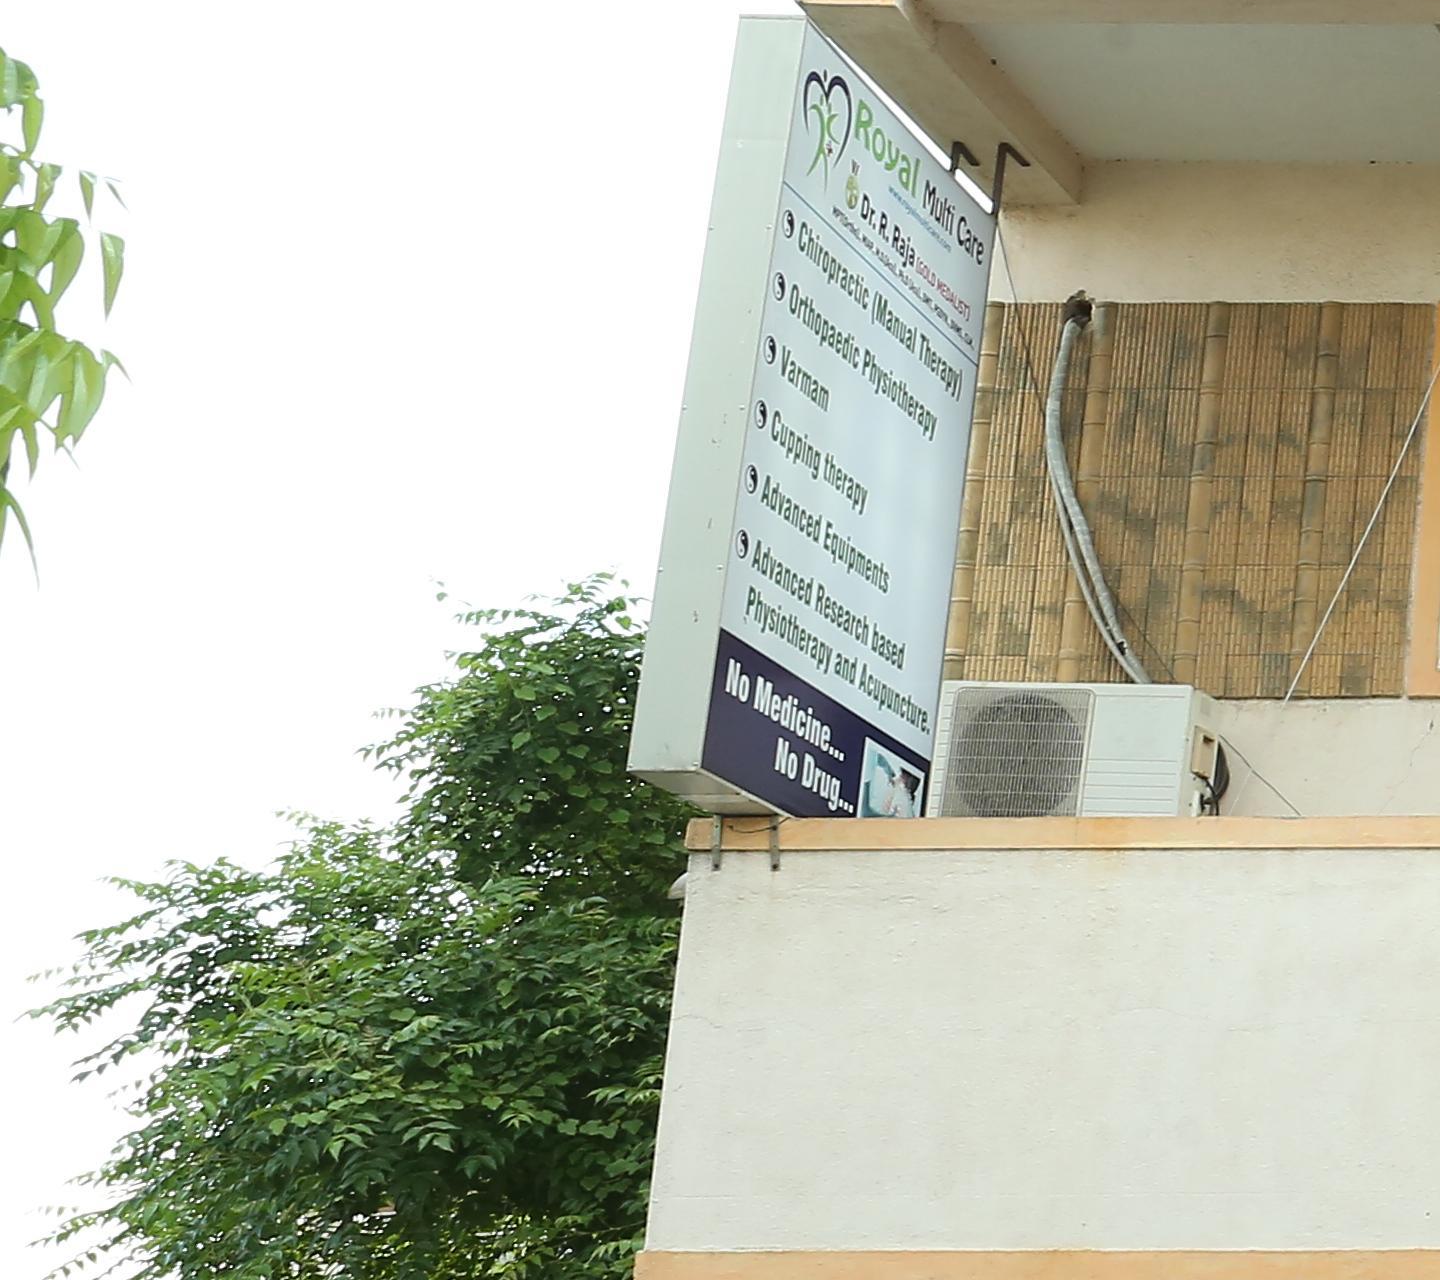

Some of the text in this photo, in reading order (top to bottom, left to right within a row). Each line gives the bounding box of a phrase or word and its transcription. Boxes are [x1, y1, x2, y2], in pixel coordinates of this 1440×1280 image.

[854, 99, 922, 197] Royal
[923, 180, 956, 236] Multi
[956, 217, 985, 265] Care
[789, 283, 938, 442] Orthopaedic Physiotherapy
[798, 221, 868, 310] Chiropractic
[871, 290, 918, 355] (Manual
[919, 333, 963, 402] Therapy)
[781, 345, 830, 412] Varmam
[771, 411, 868, 515] Cupping therapy
[761, 475, 890, 594] Advanced Equipments
[745, 585, 930, 735] Physiotherapy and Acupuncture.
[752, 540, 905, 670] Advanced Research based
[725, 658, 846, 762] No Medicine...
[775, 737, 854, 814] No Drug...
